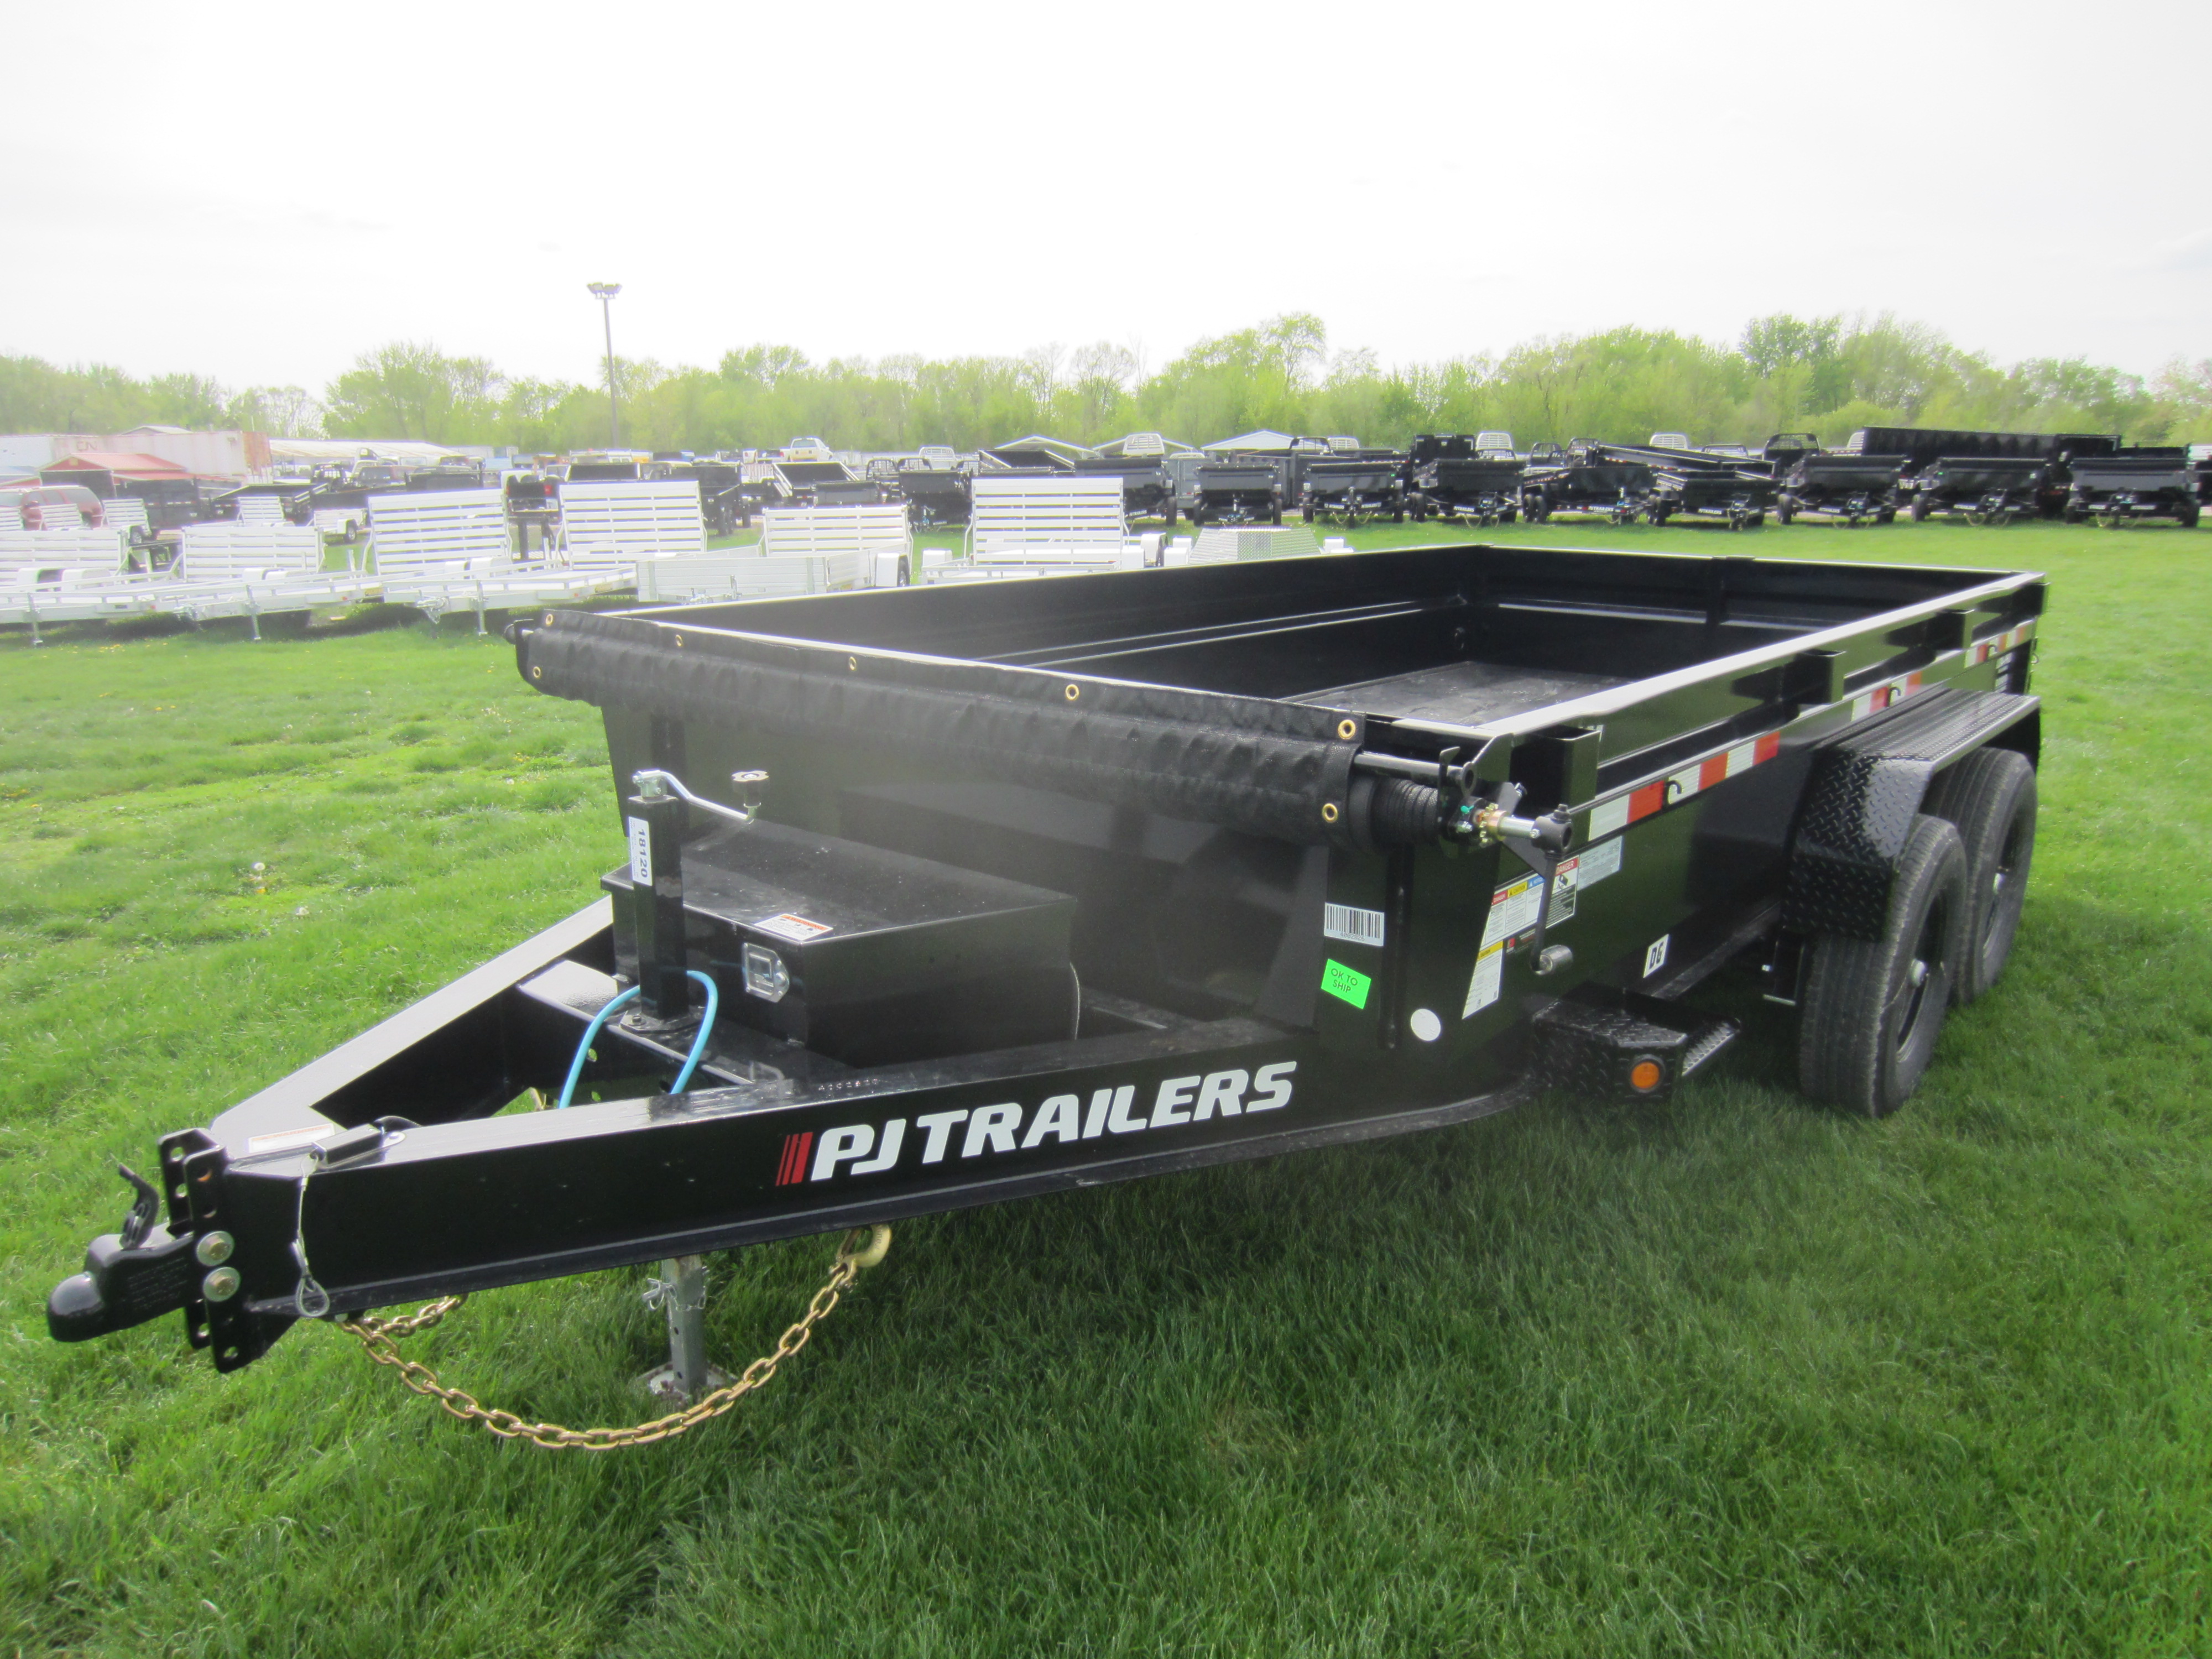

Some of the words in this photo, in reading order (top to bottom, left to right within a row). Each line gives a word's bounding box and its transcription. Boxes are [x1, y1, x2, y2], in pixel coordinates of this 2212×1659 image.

[638, 828, 648, 878] 18120
[1331, 968, 1344, 980] OK
[1347, 974, 1358, 987] TO
[1332, 979, 1352, 994] SHIP
[810, 1121, 907, 1182] PJ
[916, 1061, 1298, 1165] TRAILERS
